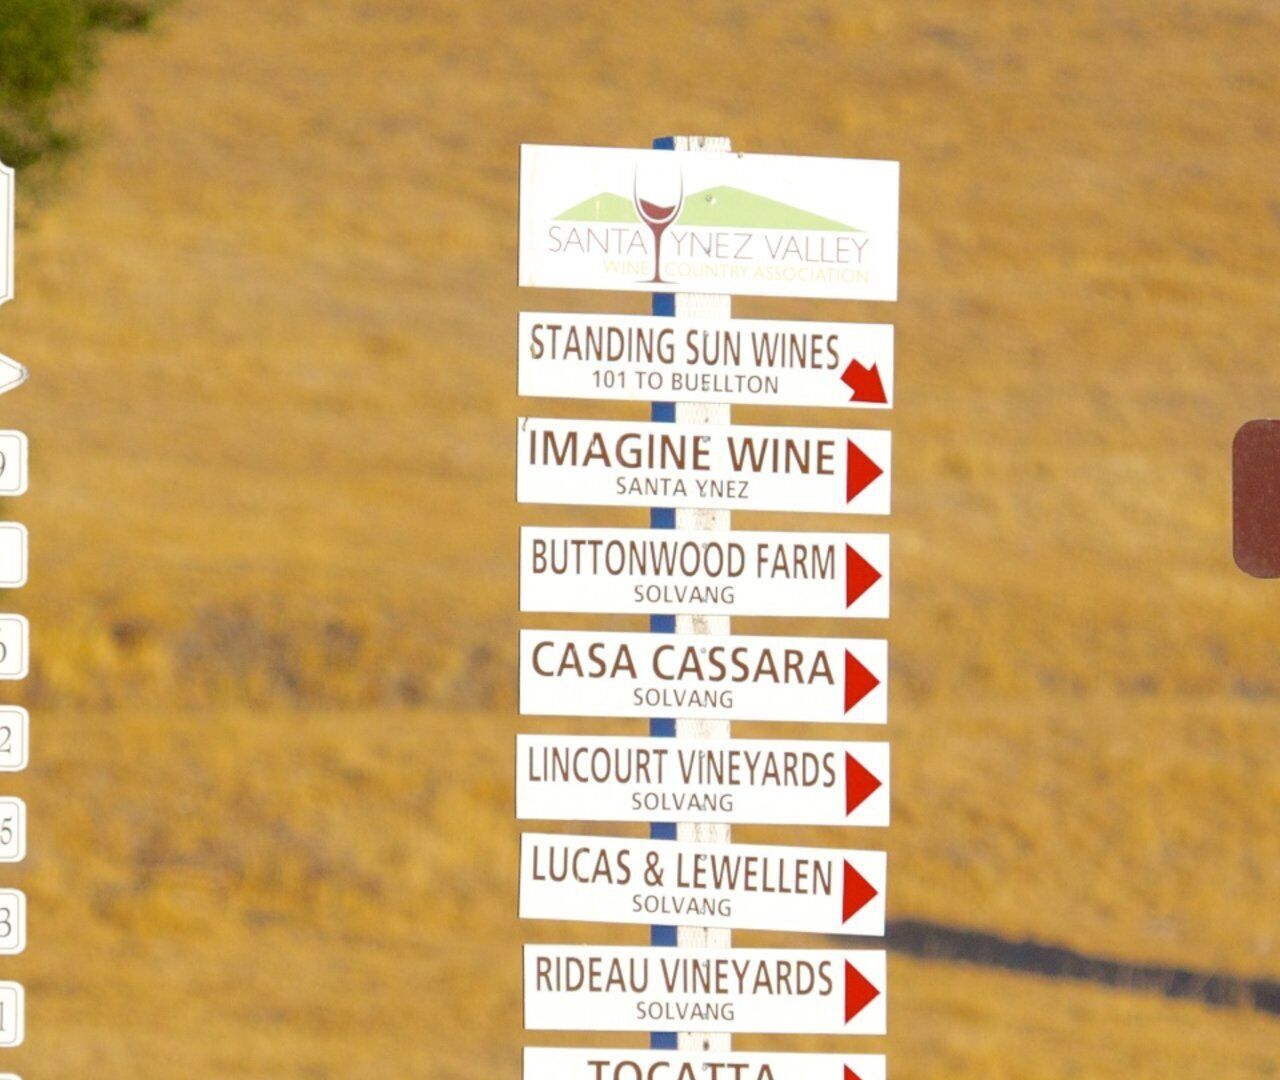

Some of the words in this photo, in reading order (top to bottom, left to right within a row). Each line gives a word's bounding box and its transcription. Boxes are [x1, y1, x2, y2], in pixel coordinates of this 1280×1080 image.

[549, 226, 648, 255] SANTA
[670, 231, 754, 260] YNEZ
[764, 235, 869, 264] VALLEY
[603, 259, 650, 276] WINE
[664, 262, 749, 279] COUNTRY
[753, 265, 870, 284] ASSOCIATION
[530, 323, 675, 365] STANDING
[686, 330, 741, 366] SUN
[751, 332, 839, 370] WINES
[593, 370, 627, 388] 101
[635, 371, 663, 390] TO
[672, 373, 779, 394] BUELLTON
[529, 430, 711, 471] IMAGINE
[727, 437, 835, 475] WINE
[616, 477, 688, 497] SANTA
[696, 479, 749, 498] YNEZ
[531, 539, 745, 578] BUTTONWOOD
[757, 543, 836, 580] FARM
[634, 584, 735, 604] SOLVANG
[531, 641, 638, 679] CASA
[652, 644, 835, 685] CASSARA
[633, 688, 734, 708] SOLVANG
[528, 747, 669, 784] LINCOURT
[677, 749, 837, 788] VINEYARDS
[632, 793, 734, 812] SOLVANG
[532, 845, 631, 885] LUCAS
[643, 851, 664, 886] &
[677, 853, 833, 895] LEWELLEN
[632, 895, 732, 917] SOLVANG
[535, 956, 649, 993] RIDEAU
[660, 958, 833, 996] VINEYARDS
[636, 1001, 736, 1021] SOLVANG
